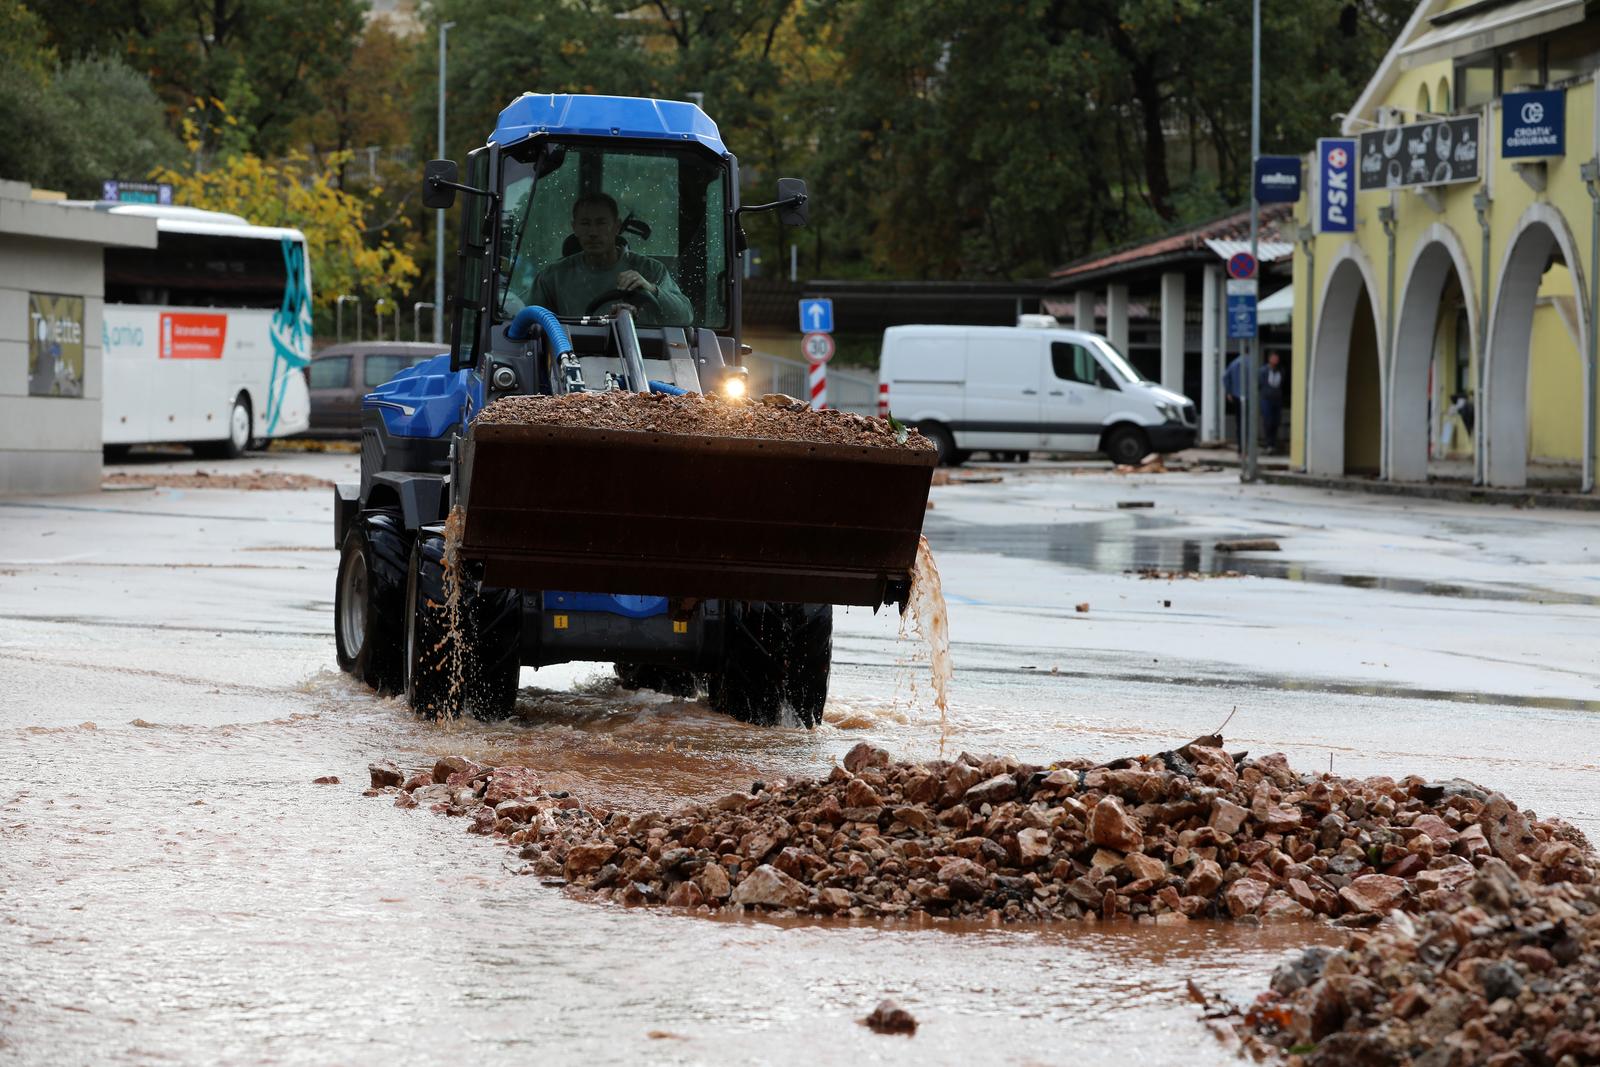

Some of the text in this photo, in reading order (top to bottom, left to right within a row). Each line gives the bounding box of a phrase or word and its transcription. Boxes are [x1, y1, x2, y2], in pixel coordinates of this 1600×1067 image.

[1514, 126, 1550, 138] CROATIA
[1506, 134, 1558, 147] OSIGURANJE
[1327, 168, 1348, 225] PSK
[810, 339, 828, 355] 30
